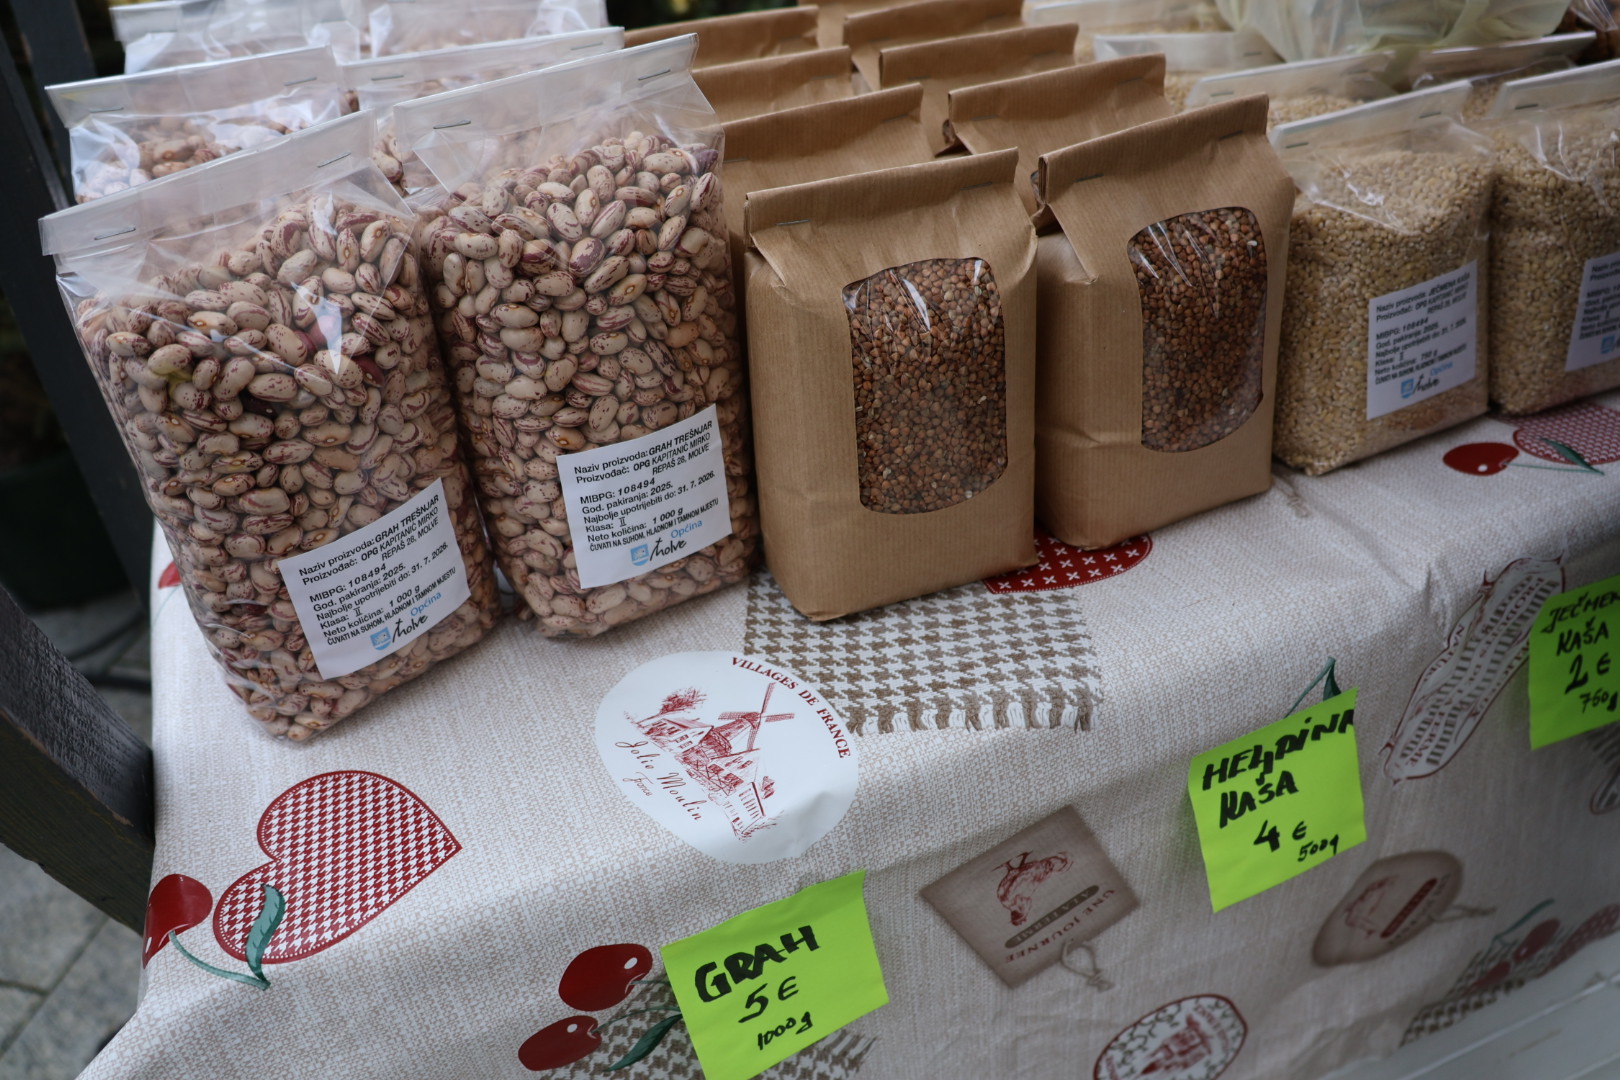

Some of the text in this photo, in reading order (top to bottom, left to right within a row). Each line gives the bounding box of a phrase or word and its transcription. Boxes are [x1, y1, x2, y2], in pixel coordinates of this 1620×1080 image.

[574, 420, 713, 475] Naziv proizvoda: GRAH TREŠNJAR
[576, 466, 630, 484] Proizvođač:
[633, 460, 650, 471] OPG
[689, 432, 711, 449] MIRKO
[652, 459, 676, 475] REPAŠ
[688, 442, 710, 461] MOLVE
[580, 477, 656, 505] MIBPG: 108494
[581, 481, 673, 515] God. pakiranja: 2025.
[583, 471, 716, 525] Najbolje upotrijebiti do: 31. 7. 2026.
[299, 494, 439, 577] Naziv proizvoda: GRAH TREŠNJAR
[381, 541, 406, 561] REPAŠ
[417, 517, 439, 539] MOLVE
[585, 521, 613, 533] Klasa:
[588, 531, 609, 543] Neto
[611, 521, 647, 538] količina:
[677, 507, 684, 516] g
[589, 540, 613, 552] ČUVATI
[613, 539, 622, 547] NA
[622, 530, 646, 546] SUHOM,
[646, 520, 674, 537] HLADNOM
[677, 507, 700, 525] TAMNOM
[698, 497, 719, 515] MJESTU
[670, 519, 703, 539] Općina
[302, 557, 358, 586] Proizvođač:
[361, 548, 379, 562] OPG
[418, 506, 439, 529] MIRKO
[309, 563, 387, 603] MIBPG: 108494
[313, 564, 406, 612] God. pakiranja: 2025.
[316, 541, 449, 621] Najbolje upotrijebiti do: 31. 7. 2026.
[320, 614, 349, 630] Klasa:
[323, 626, 347, 638] Neto
[348, 608, 384, 629] količina:
[414, 585, 421, 594] g
[326, 632, 351, 646] ČUVATI
[351, 629, 361, 638] NA
[361, 618, 385, 635] SUHOM,
[385, 601, 412, 621] HLADNOM
[415, 584, 438, 604] TAMNOM
[436, 567, 456, 588] MJESTU
[410, 592, 442, 617] Općina
[1556, 616, 1609, 657] KAŠA
[1565, 654, 1588, 695] 2
[731, 657, 851, 759] VILLAGES DE FRANCE
[615, 740, 661, 770] Jolie
[656, 772, 708, 821] Moulin
[1219, 770, 1299, 829] KAŠA
[1253, 819, 1280, 852] 4
[1082, 889, 1116, 916] UNE
[695, 925, 821, 1003] GRAH
[738, 983, 769, 1024] 5
